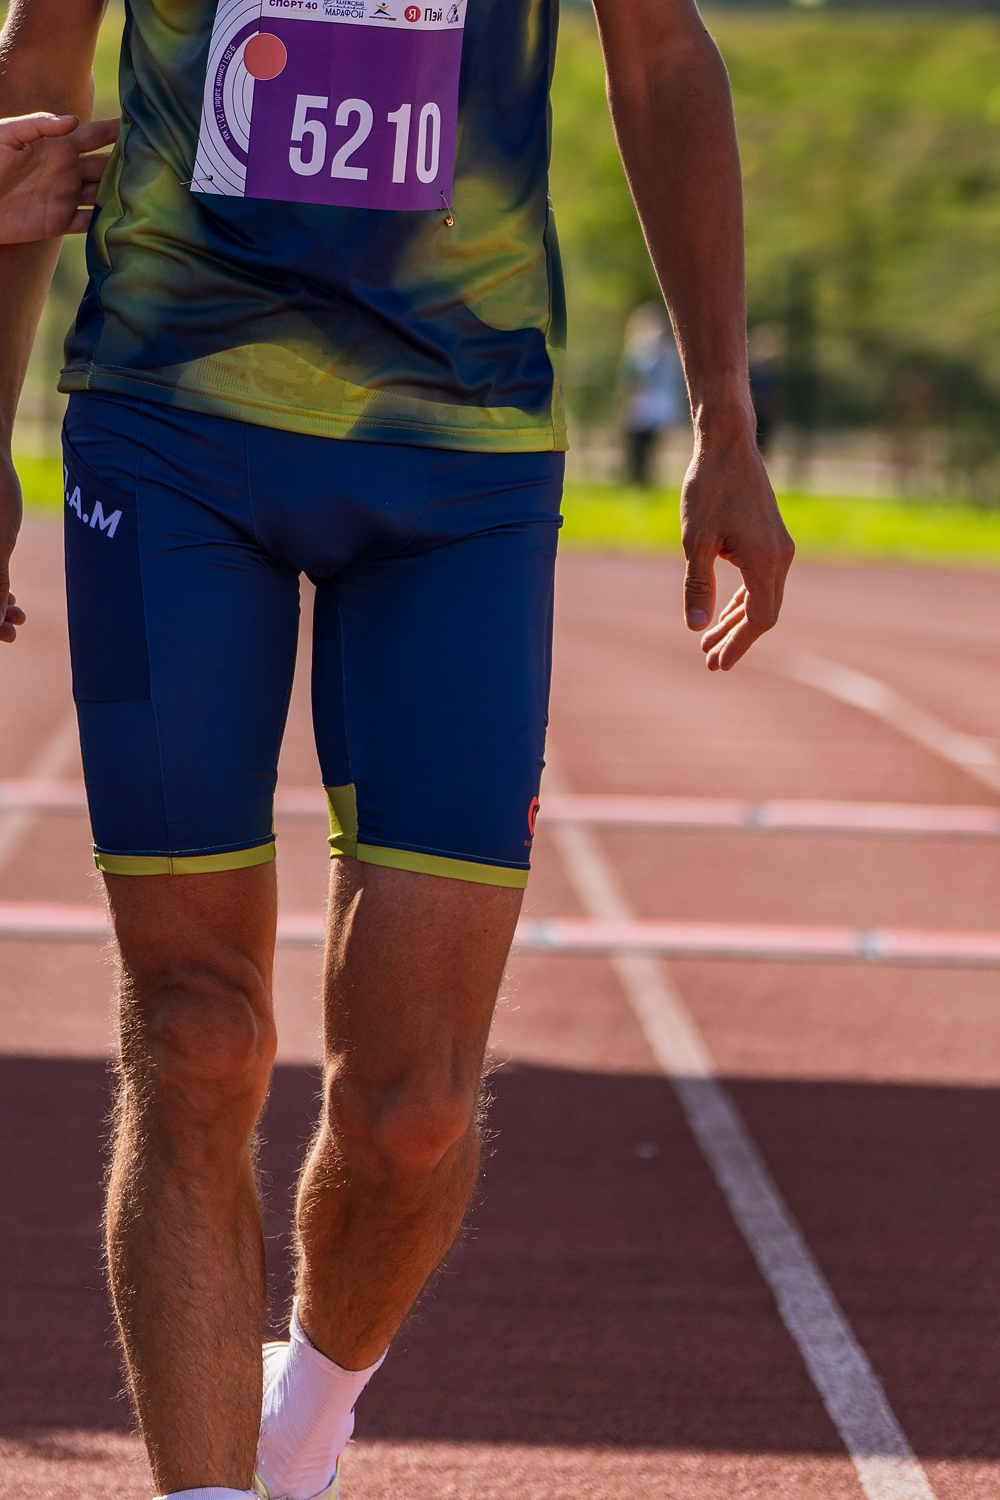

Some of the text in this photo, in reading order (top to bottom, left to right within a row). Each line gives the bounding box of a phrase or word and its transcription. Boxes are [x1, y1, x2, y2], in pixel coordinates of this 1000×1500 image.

[269, 0, 318, 10] СПОРТ 40
[325, 8, 364, 18] МАРАФОН
[408, 8, 417, 20] Я
[424, 8, 443, 22] Пэй
